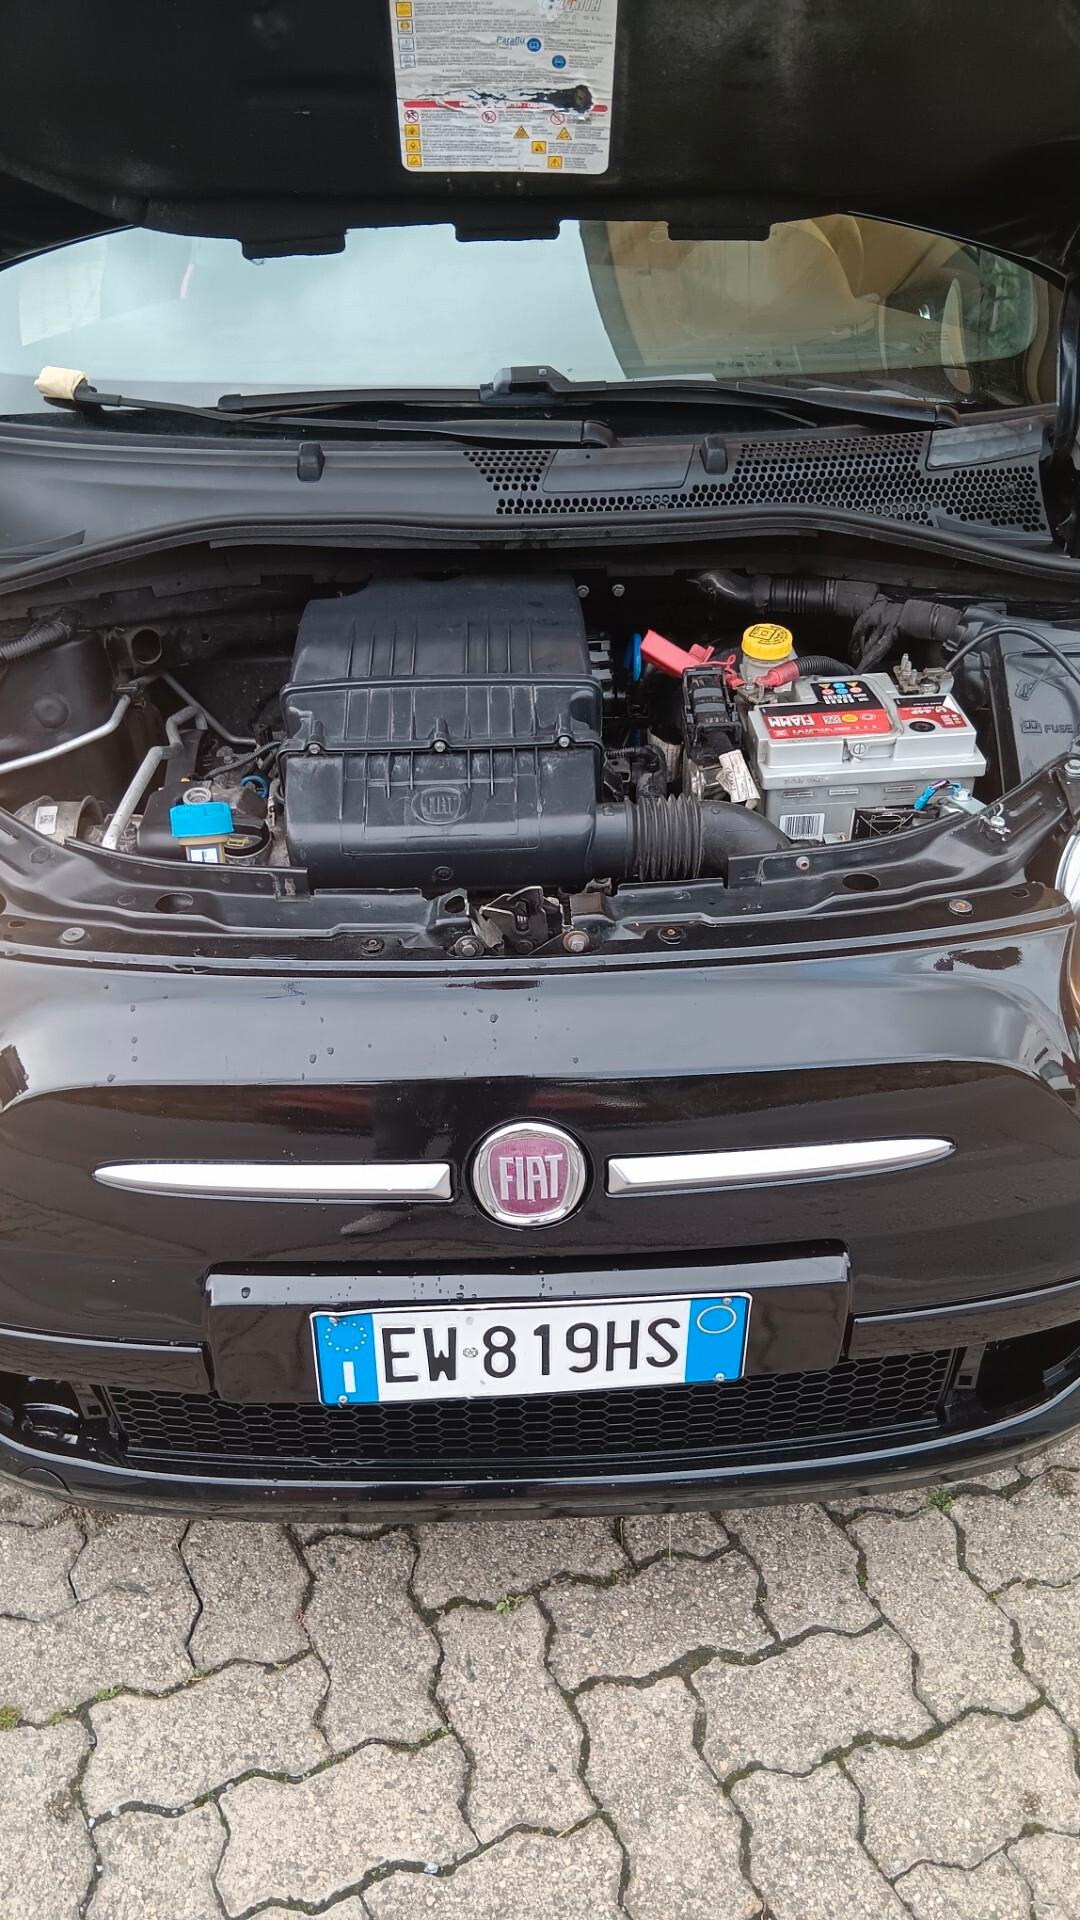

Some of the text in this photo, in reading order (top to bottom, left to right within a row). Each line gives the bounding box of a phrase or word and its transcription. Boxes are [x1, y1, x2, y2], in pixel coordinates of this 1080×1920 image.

[768, 714, 815, 728] FIAMM
[1044, 723, 1074, 734] FUSE
[425, 796, 457, 815] FIAT
[499, 1153, 564, 1201] FIAT
